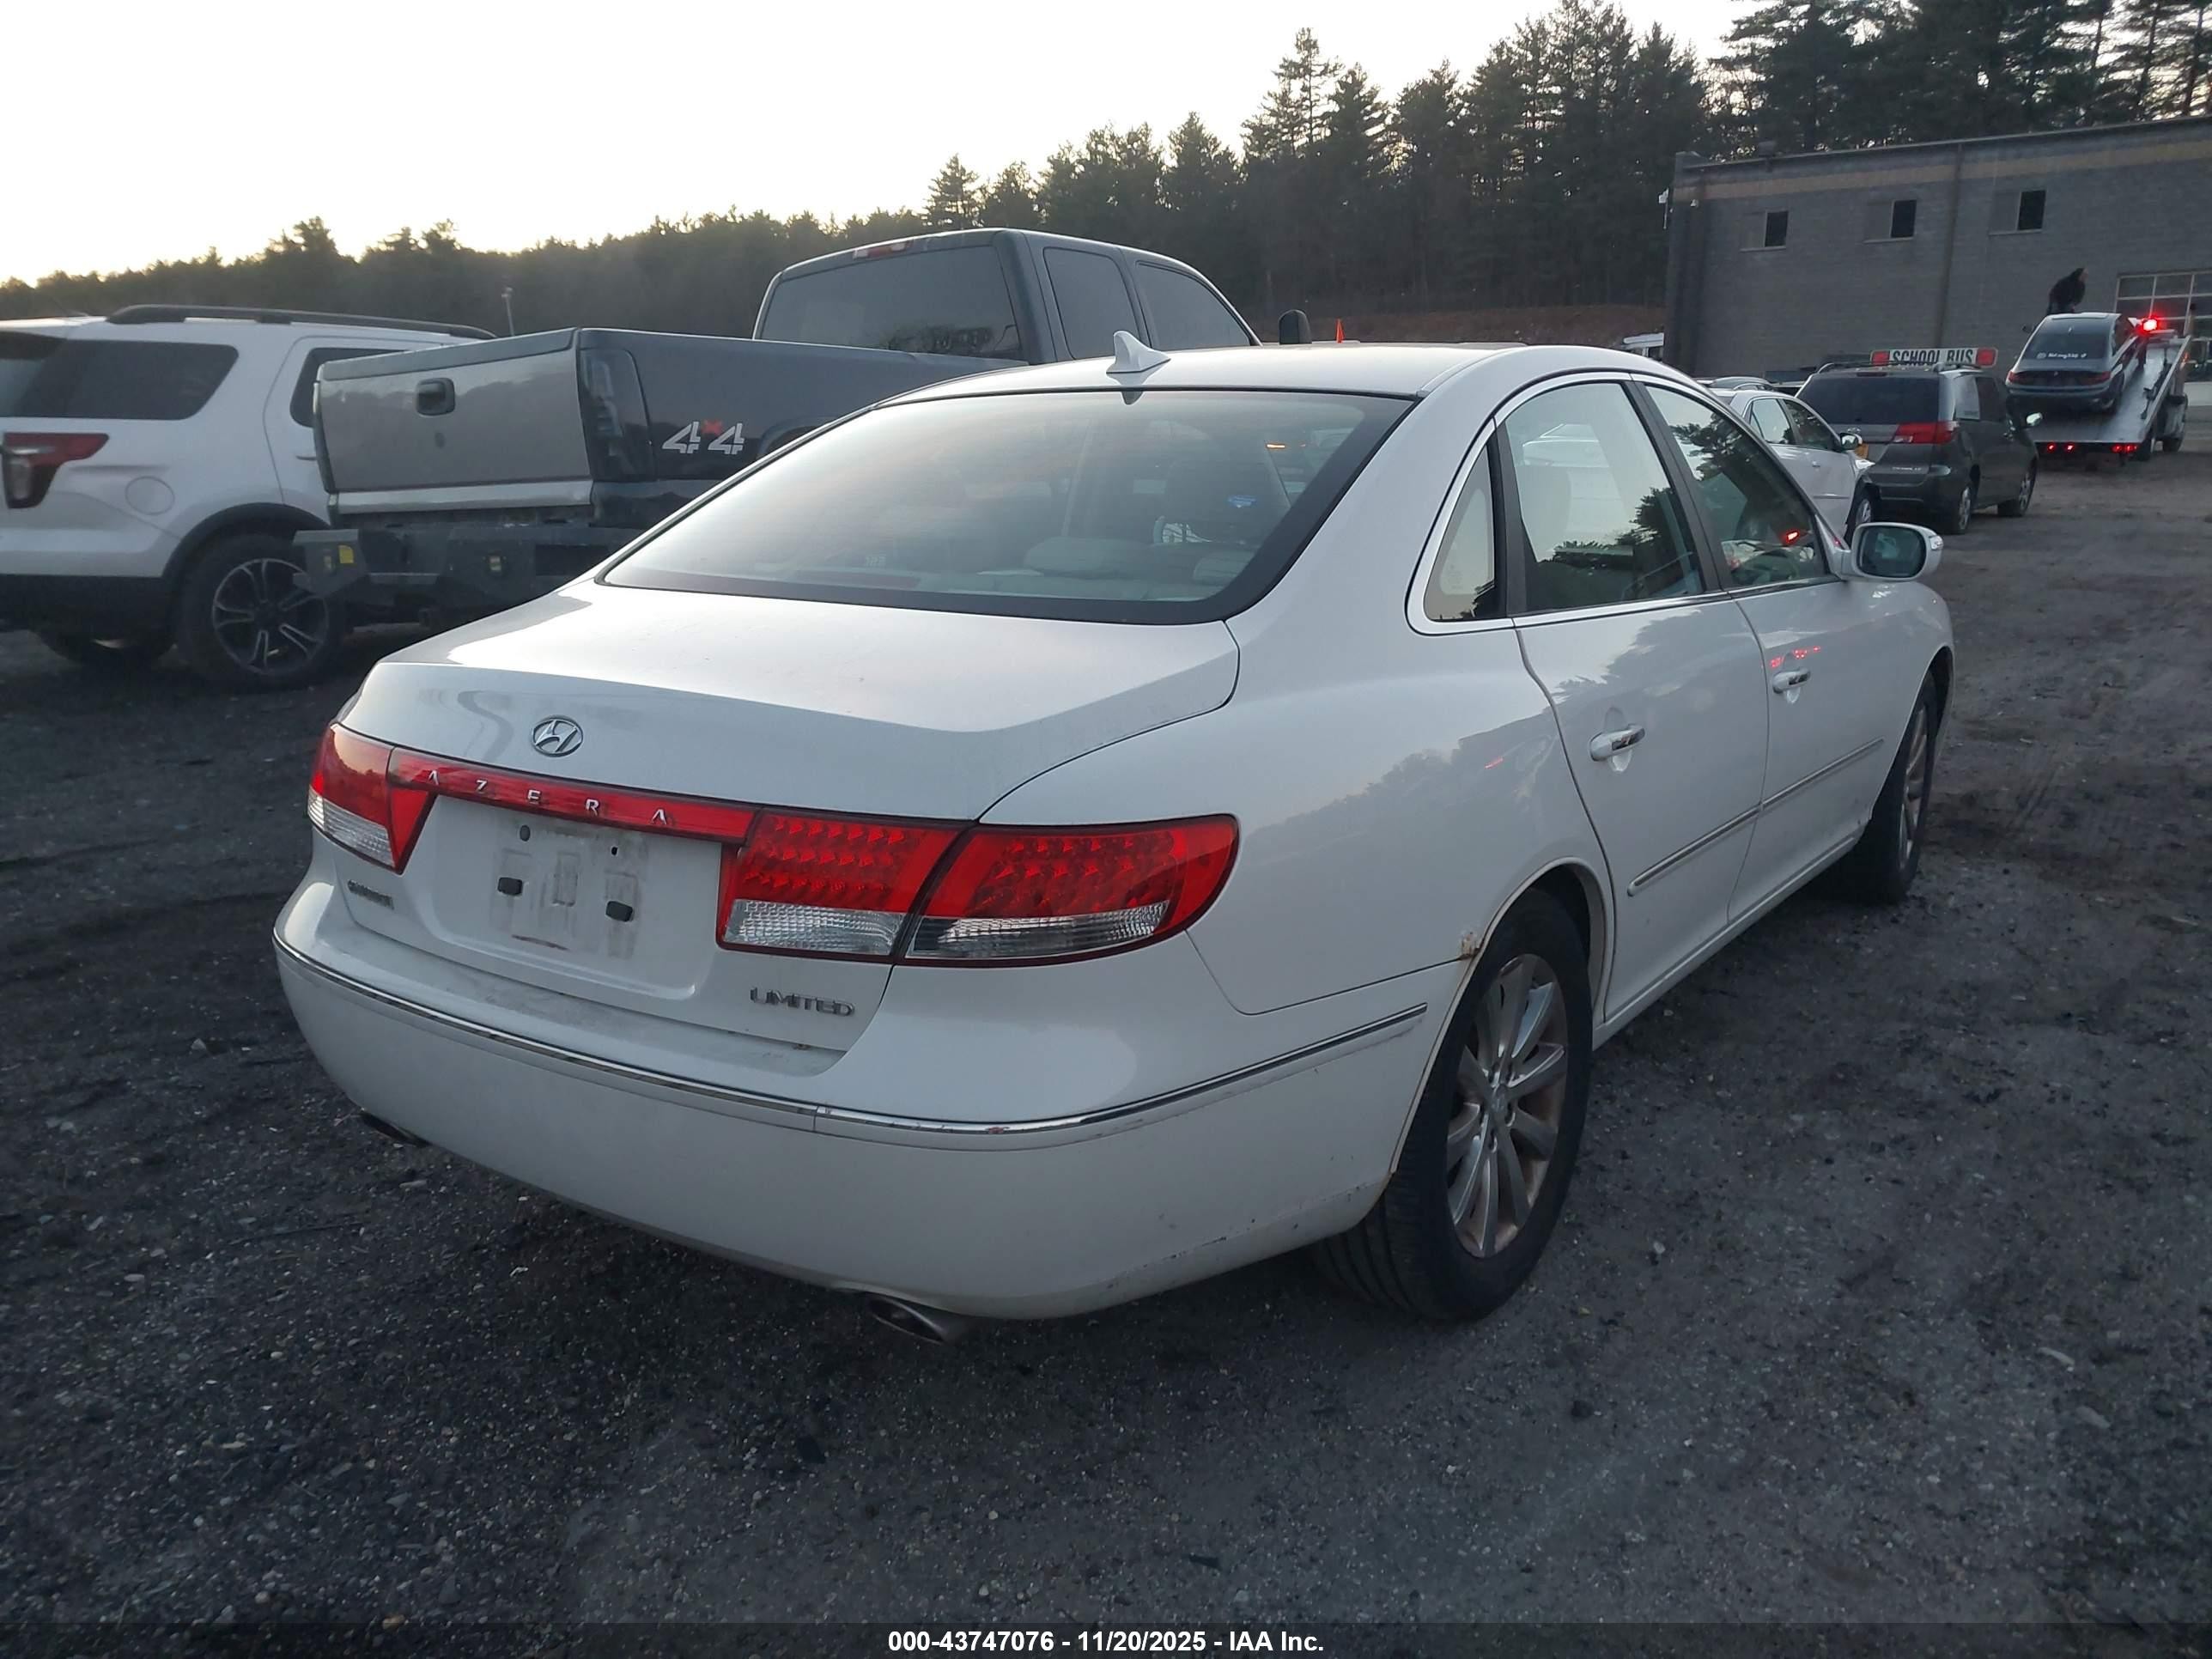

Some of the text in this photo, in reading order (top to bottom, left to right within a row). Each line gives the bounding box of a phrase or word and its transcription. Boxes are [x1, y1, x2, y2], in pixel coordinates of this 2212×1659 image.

[1893, 348, 1974, 365] SCHOOL BUS
[428, 769, 666, 824] AZERA
[750, 988, 855, 1016] LIMITED
